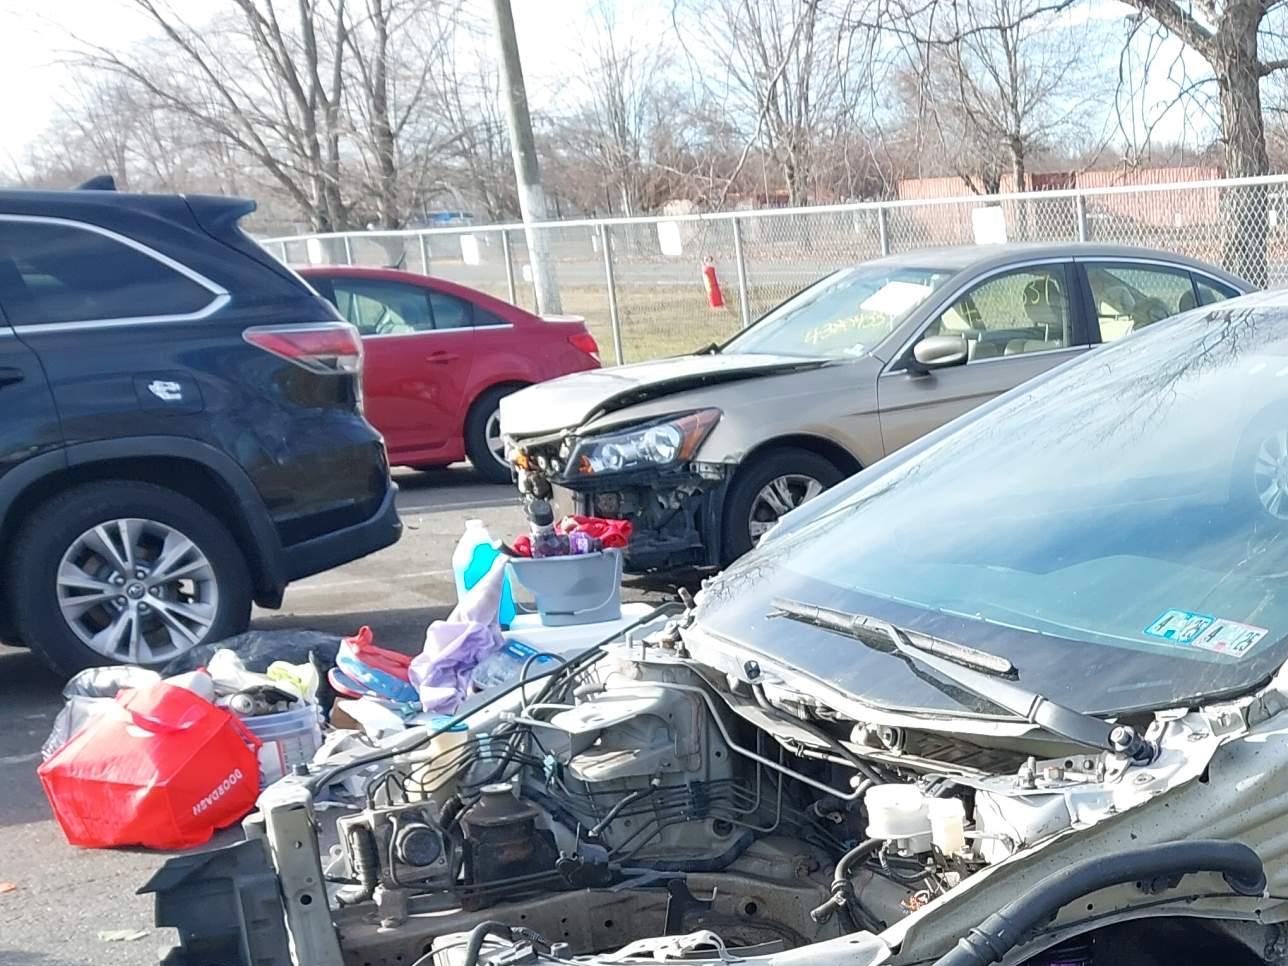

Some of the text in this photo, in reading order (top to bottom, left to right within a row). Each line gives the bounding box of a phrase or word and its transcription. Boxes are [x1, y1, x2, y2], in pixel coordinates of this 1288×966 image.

[1155, 615, 1175, 632] 4
[1203, 625, 1262, 652] 4 25
[192, 768, 243, 816] DOORDASH
